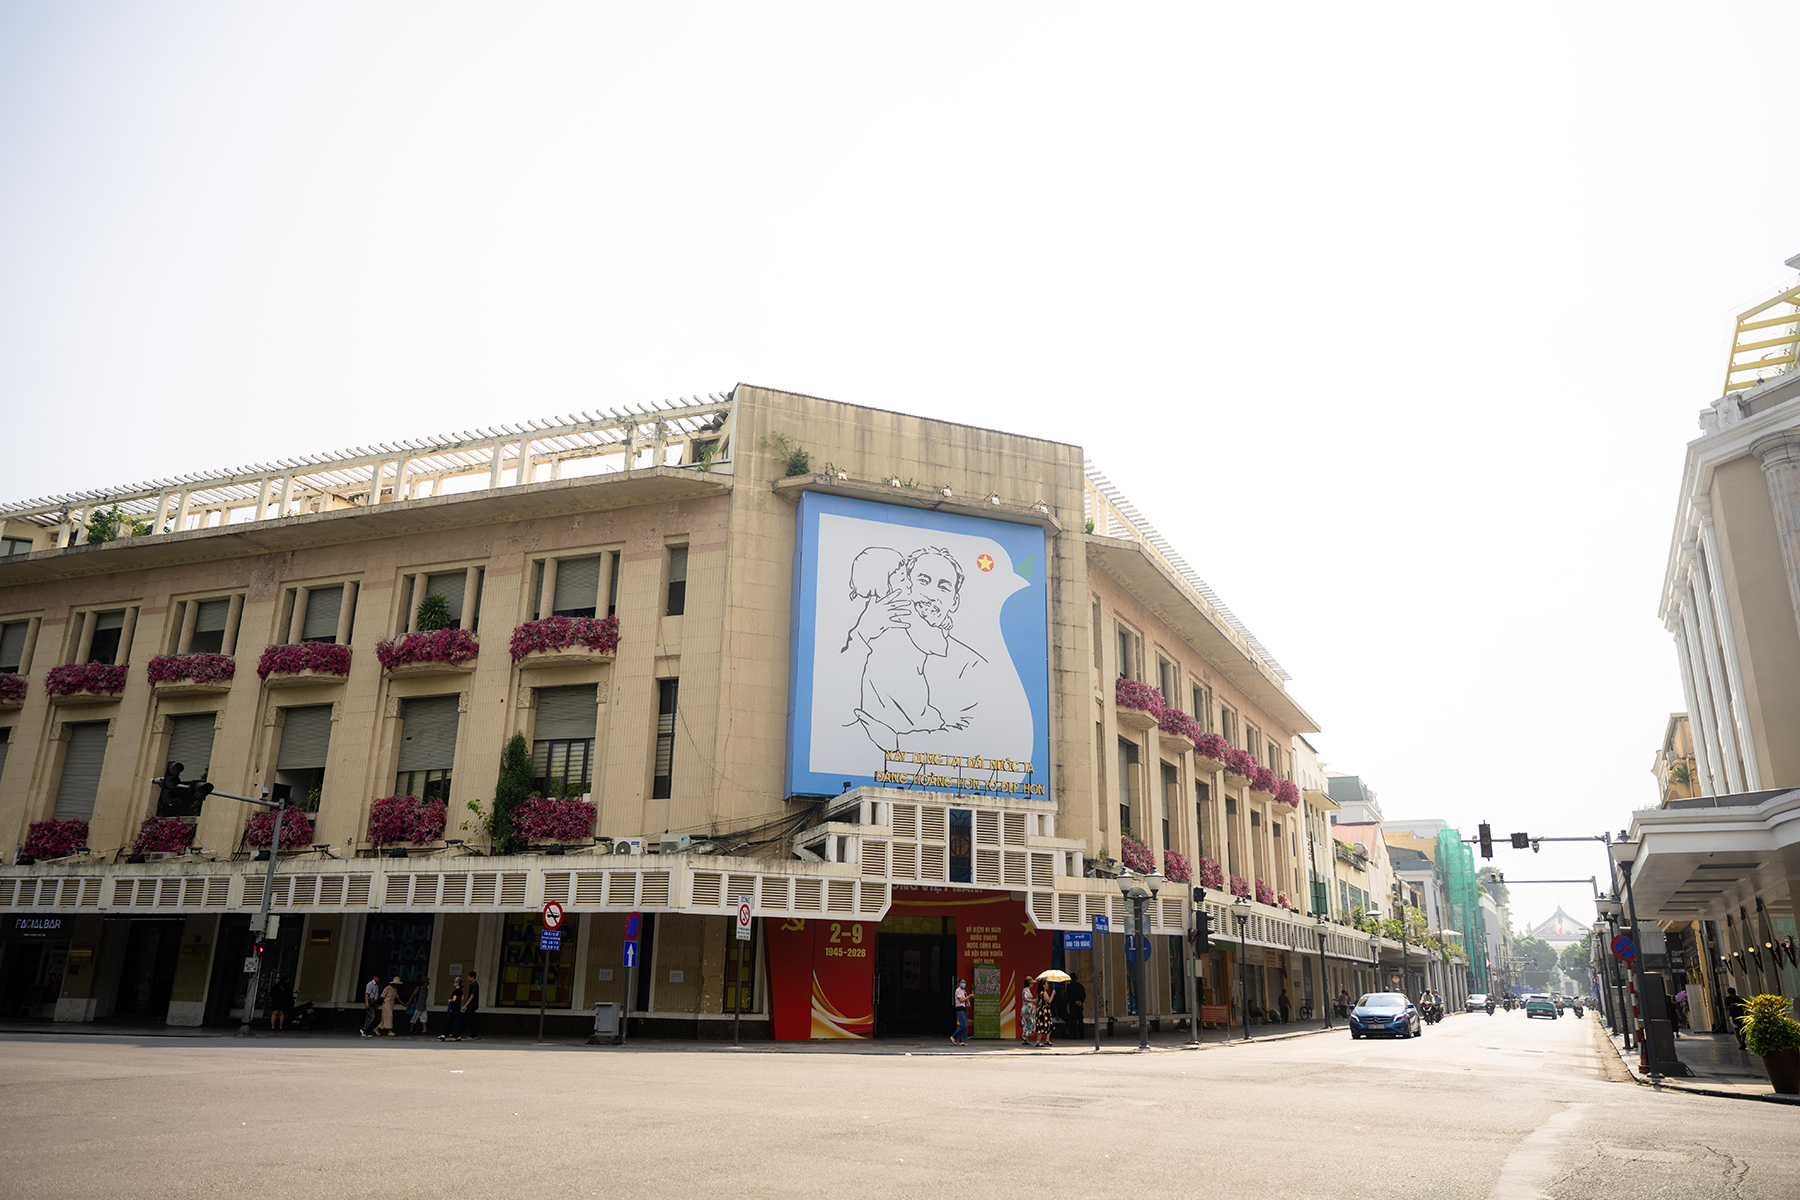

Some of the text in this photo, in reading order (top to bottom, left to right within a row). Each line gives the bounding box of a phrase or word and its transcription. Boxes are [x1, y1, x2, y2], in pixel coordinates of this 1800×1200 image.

[886, 747, 1035, 774] XÂY DỰNG LẠI ĐẤT NƯỚC TA
[875, 768, 1045, 796] ĐÀNG HOÀNG HƠN TO ĐẸP HƠN
[829, 922, 863, 944] 2-9
[824, 946, 867, 958] 1945-2026
